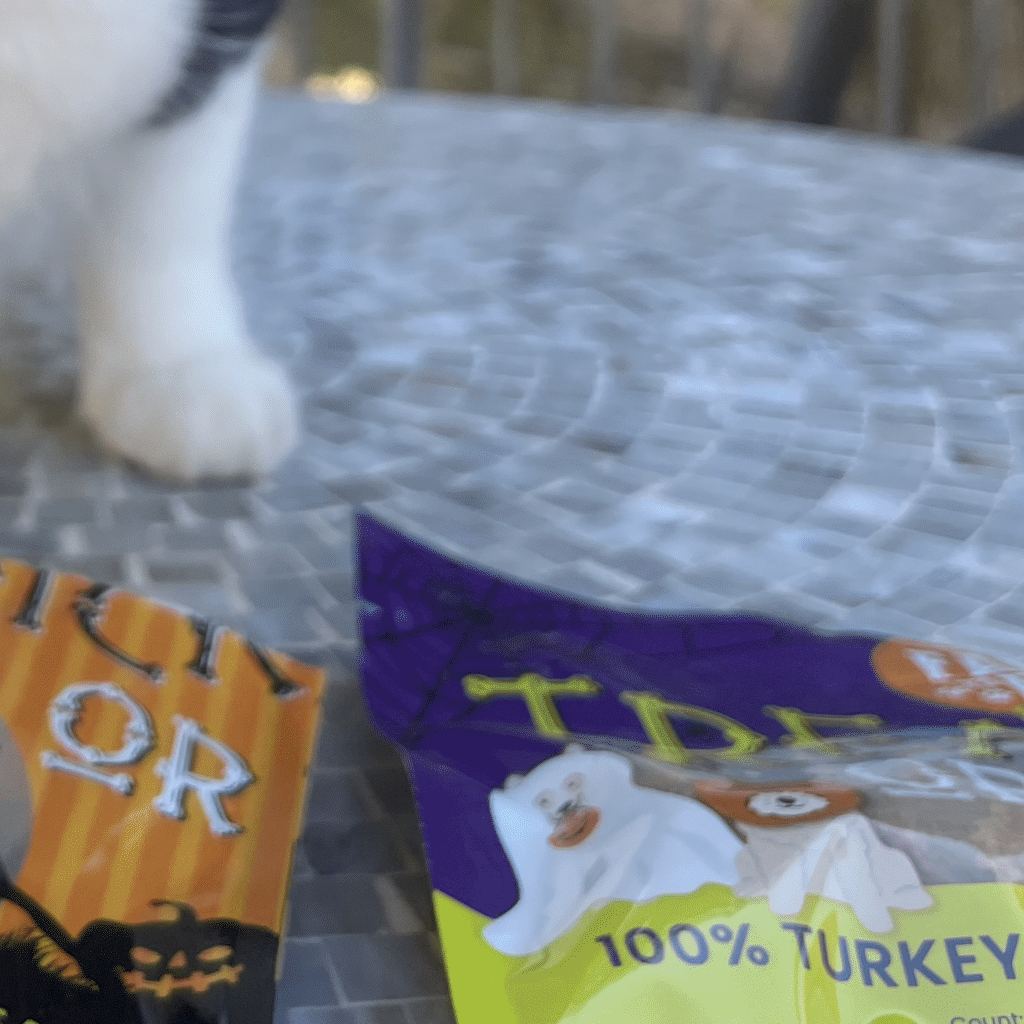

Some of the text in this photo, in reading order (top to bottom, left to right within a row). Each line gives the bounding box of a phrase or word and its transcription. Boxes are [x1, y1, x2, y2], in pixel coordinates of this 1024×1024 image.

[39, 681, 257, 837] OR
[596, 922, 1021, 988] 100% TURKEY
